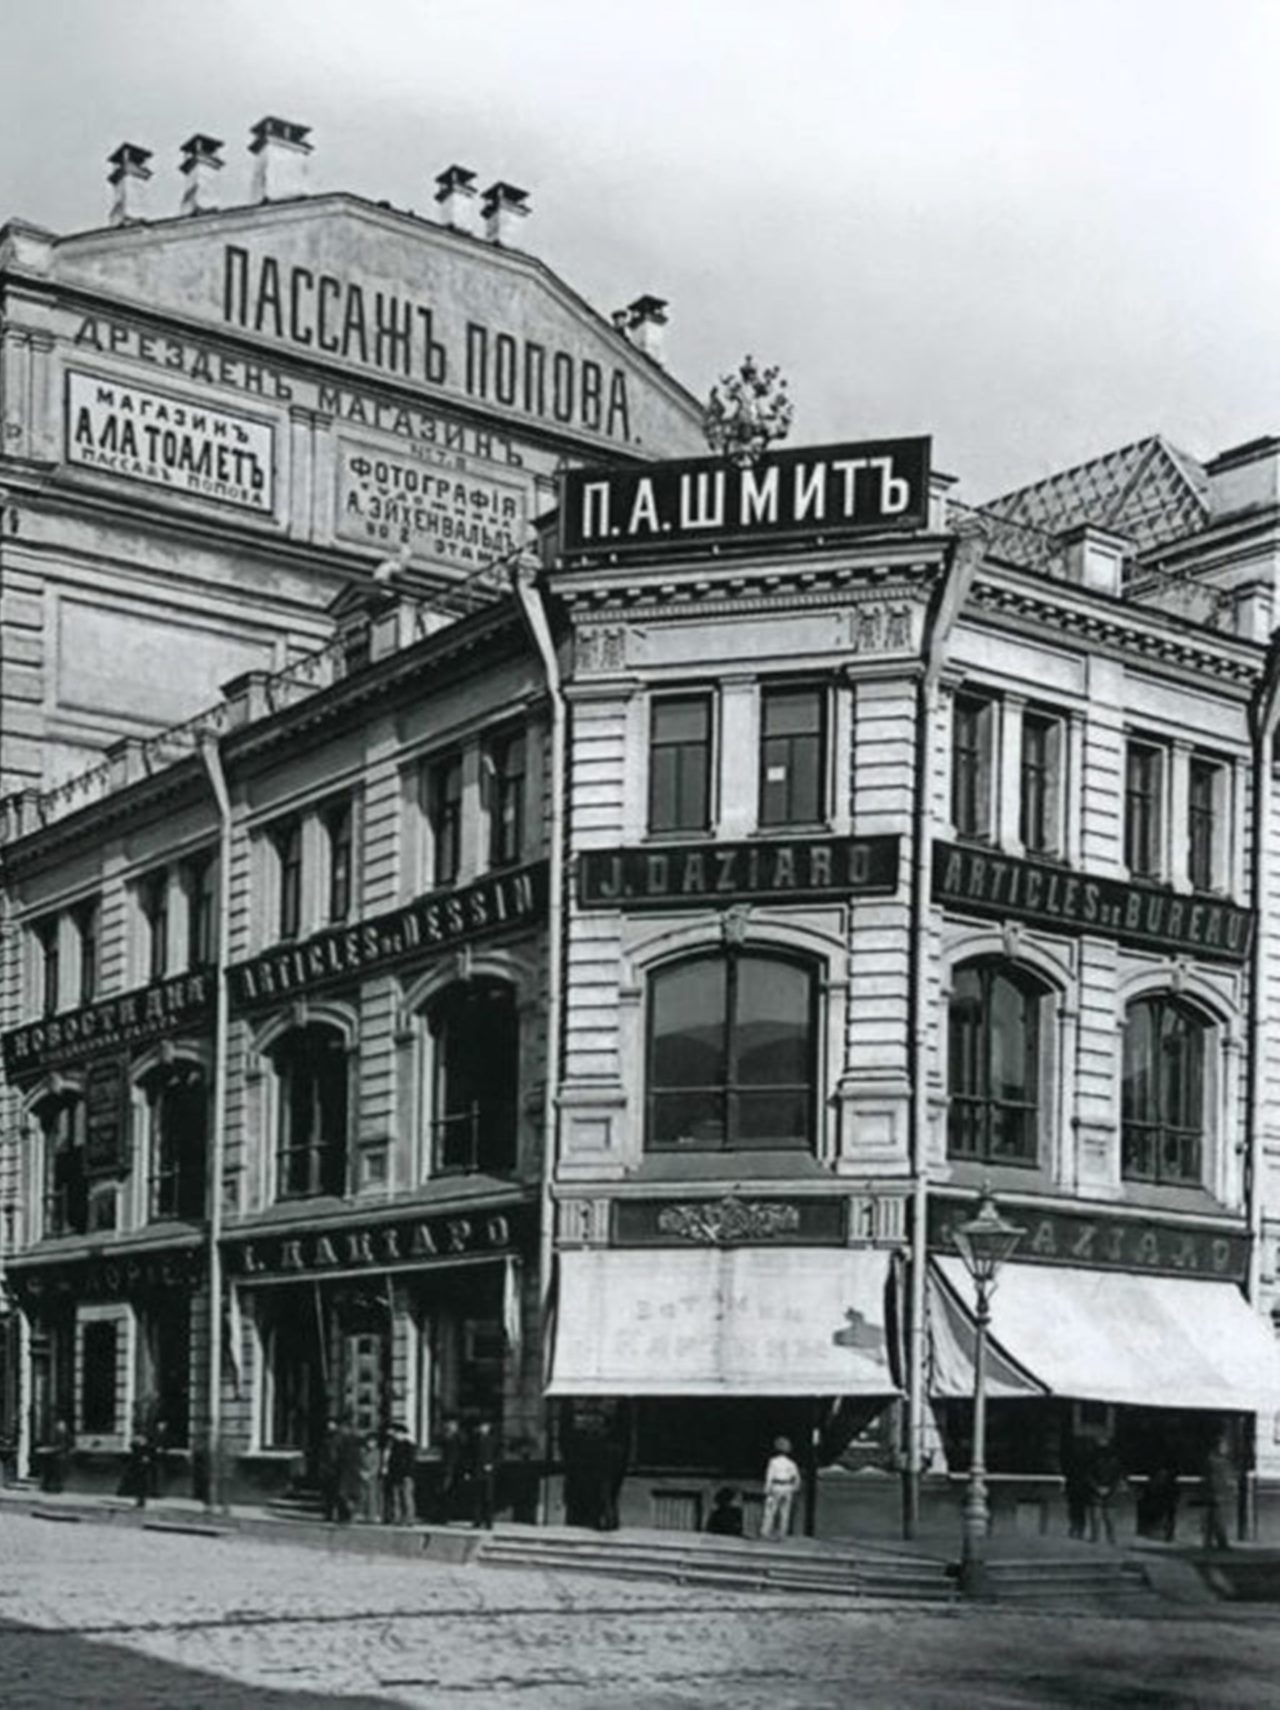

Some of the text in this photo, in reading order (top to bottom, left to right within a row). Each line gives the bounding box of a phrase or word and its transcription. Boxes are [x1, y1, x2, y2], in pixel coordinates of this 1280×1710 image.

[224, 244, 642, 445] ПАССАЖЪ ПОПОВА.
[74, 315, 523, 467] ДРЕЗДЕНЪ МАГАЗИНЪ
[97, 387, 249, 443] МАГАЗИНЪ
[349, 456, 517, 519] ФОТОГРАФІЯ
[646, 844, 872, 894] DAZIARO
[944, 851, 1100, 921] ARTICLES
[1125, 891, 1246, 949] BUREAU
[243, 928, 379, 999] ARTICLES
[404, 873, 533, 946] DESSIN
[1032, 1220, 1231, 1271] AZIARO
